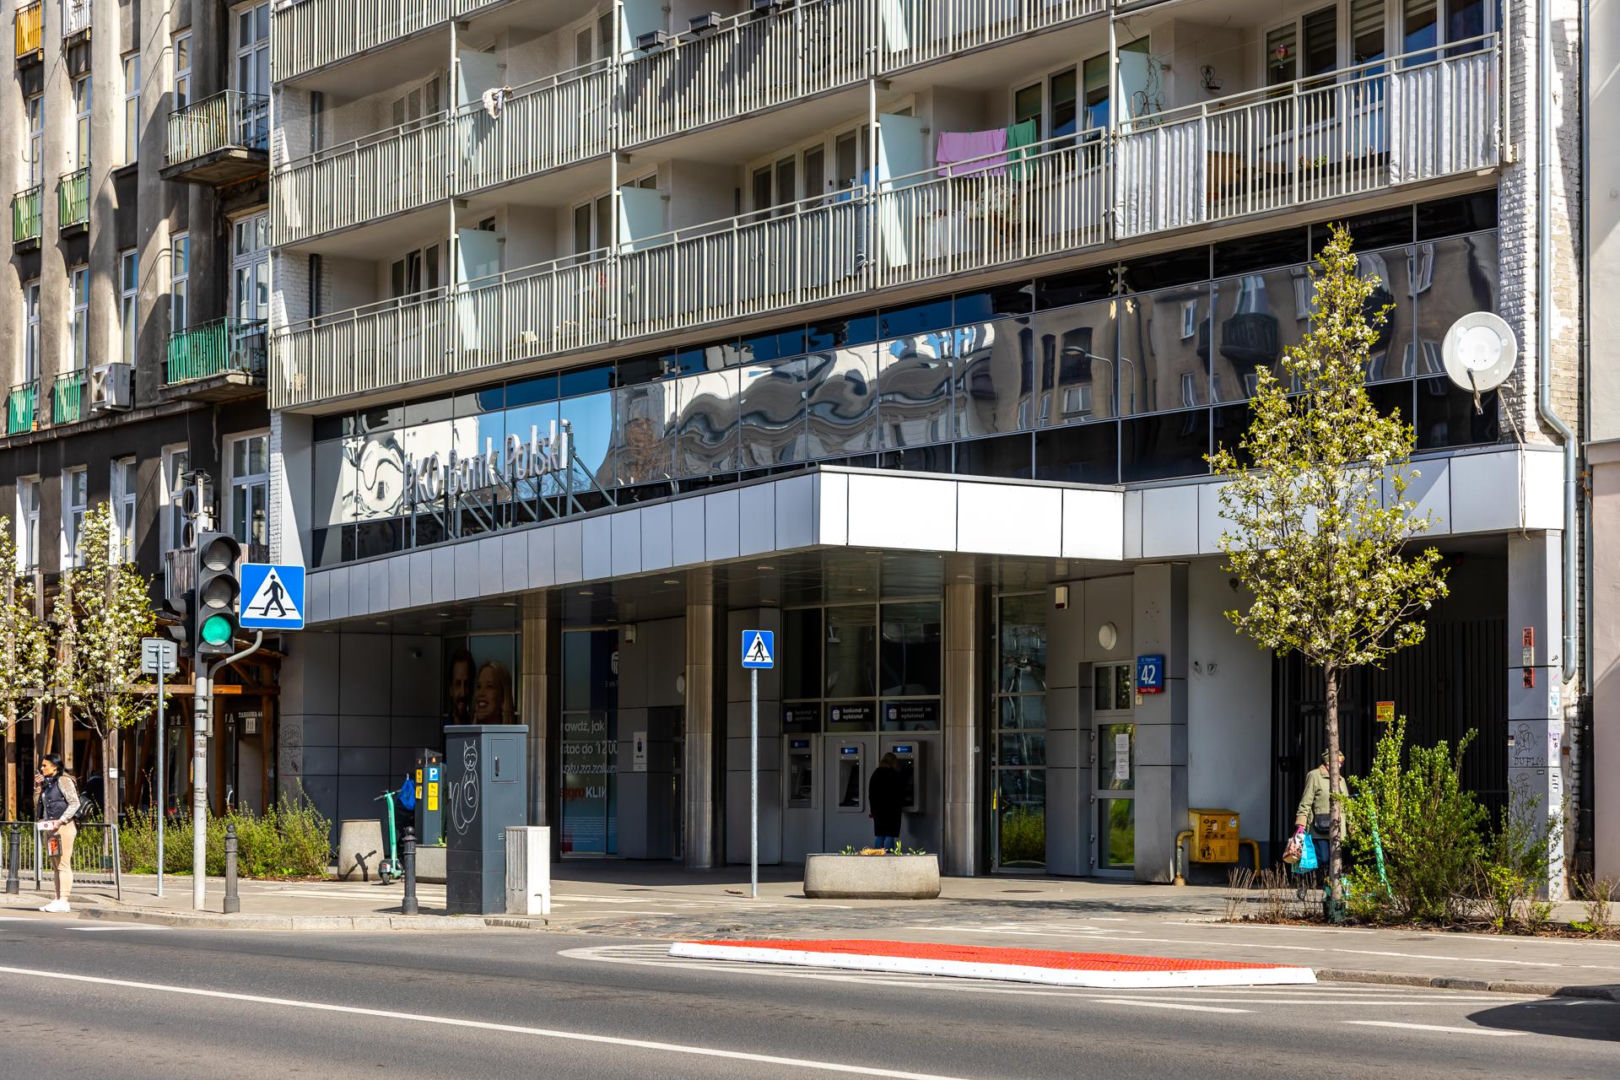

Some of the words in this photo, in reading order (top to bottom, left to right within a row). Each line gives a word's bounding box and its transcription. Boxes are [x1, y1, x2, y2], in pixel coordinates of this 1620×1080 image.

[404, 454, 440, 506] PKO
[448, 437, 499, 496] Bank
[505, 419, 571, 482] Polski
[1141, 665, 1156, 684] 42
[582, 743, 593, 754] do
[429, 768, 438, 778] P
